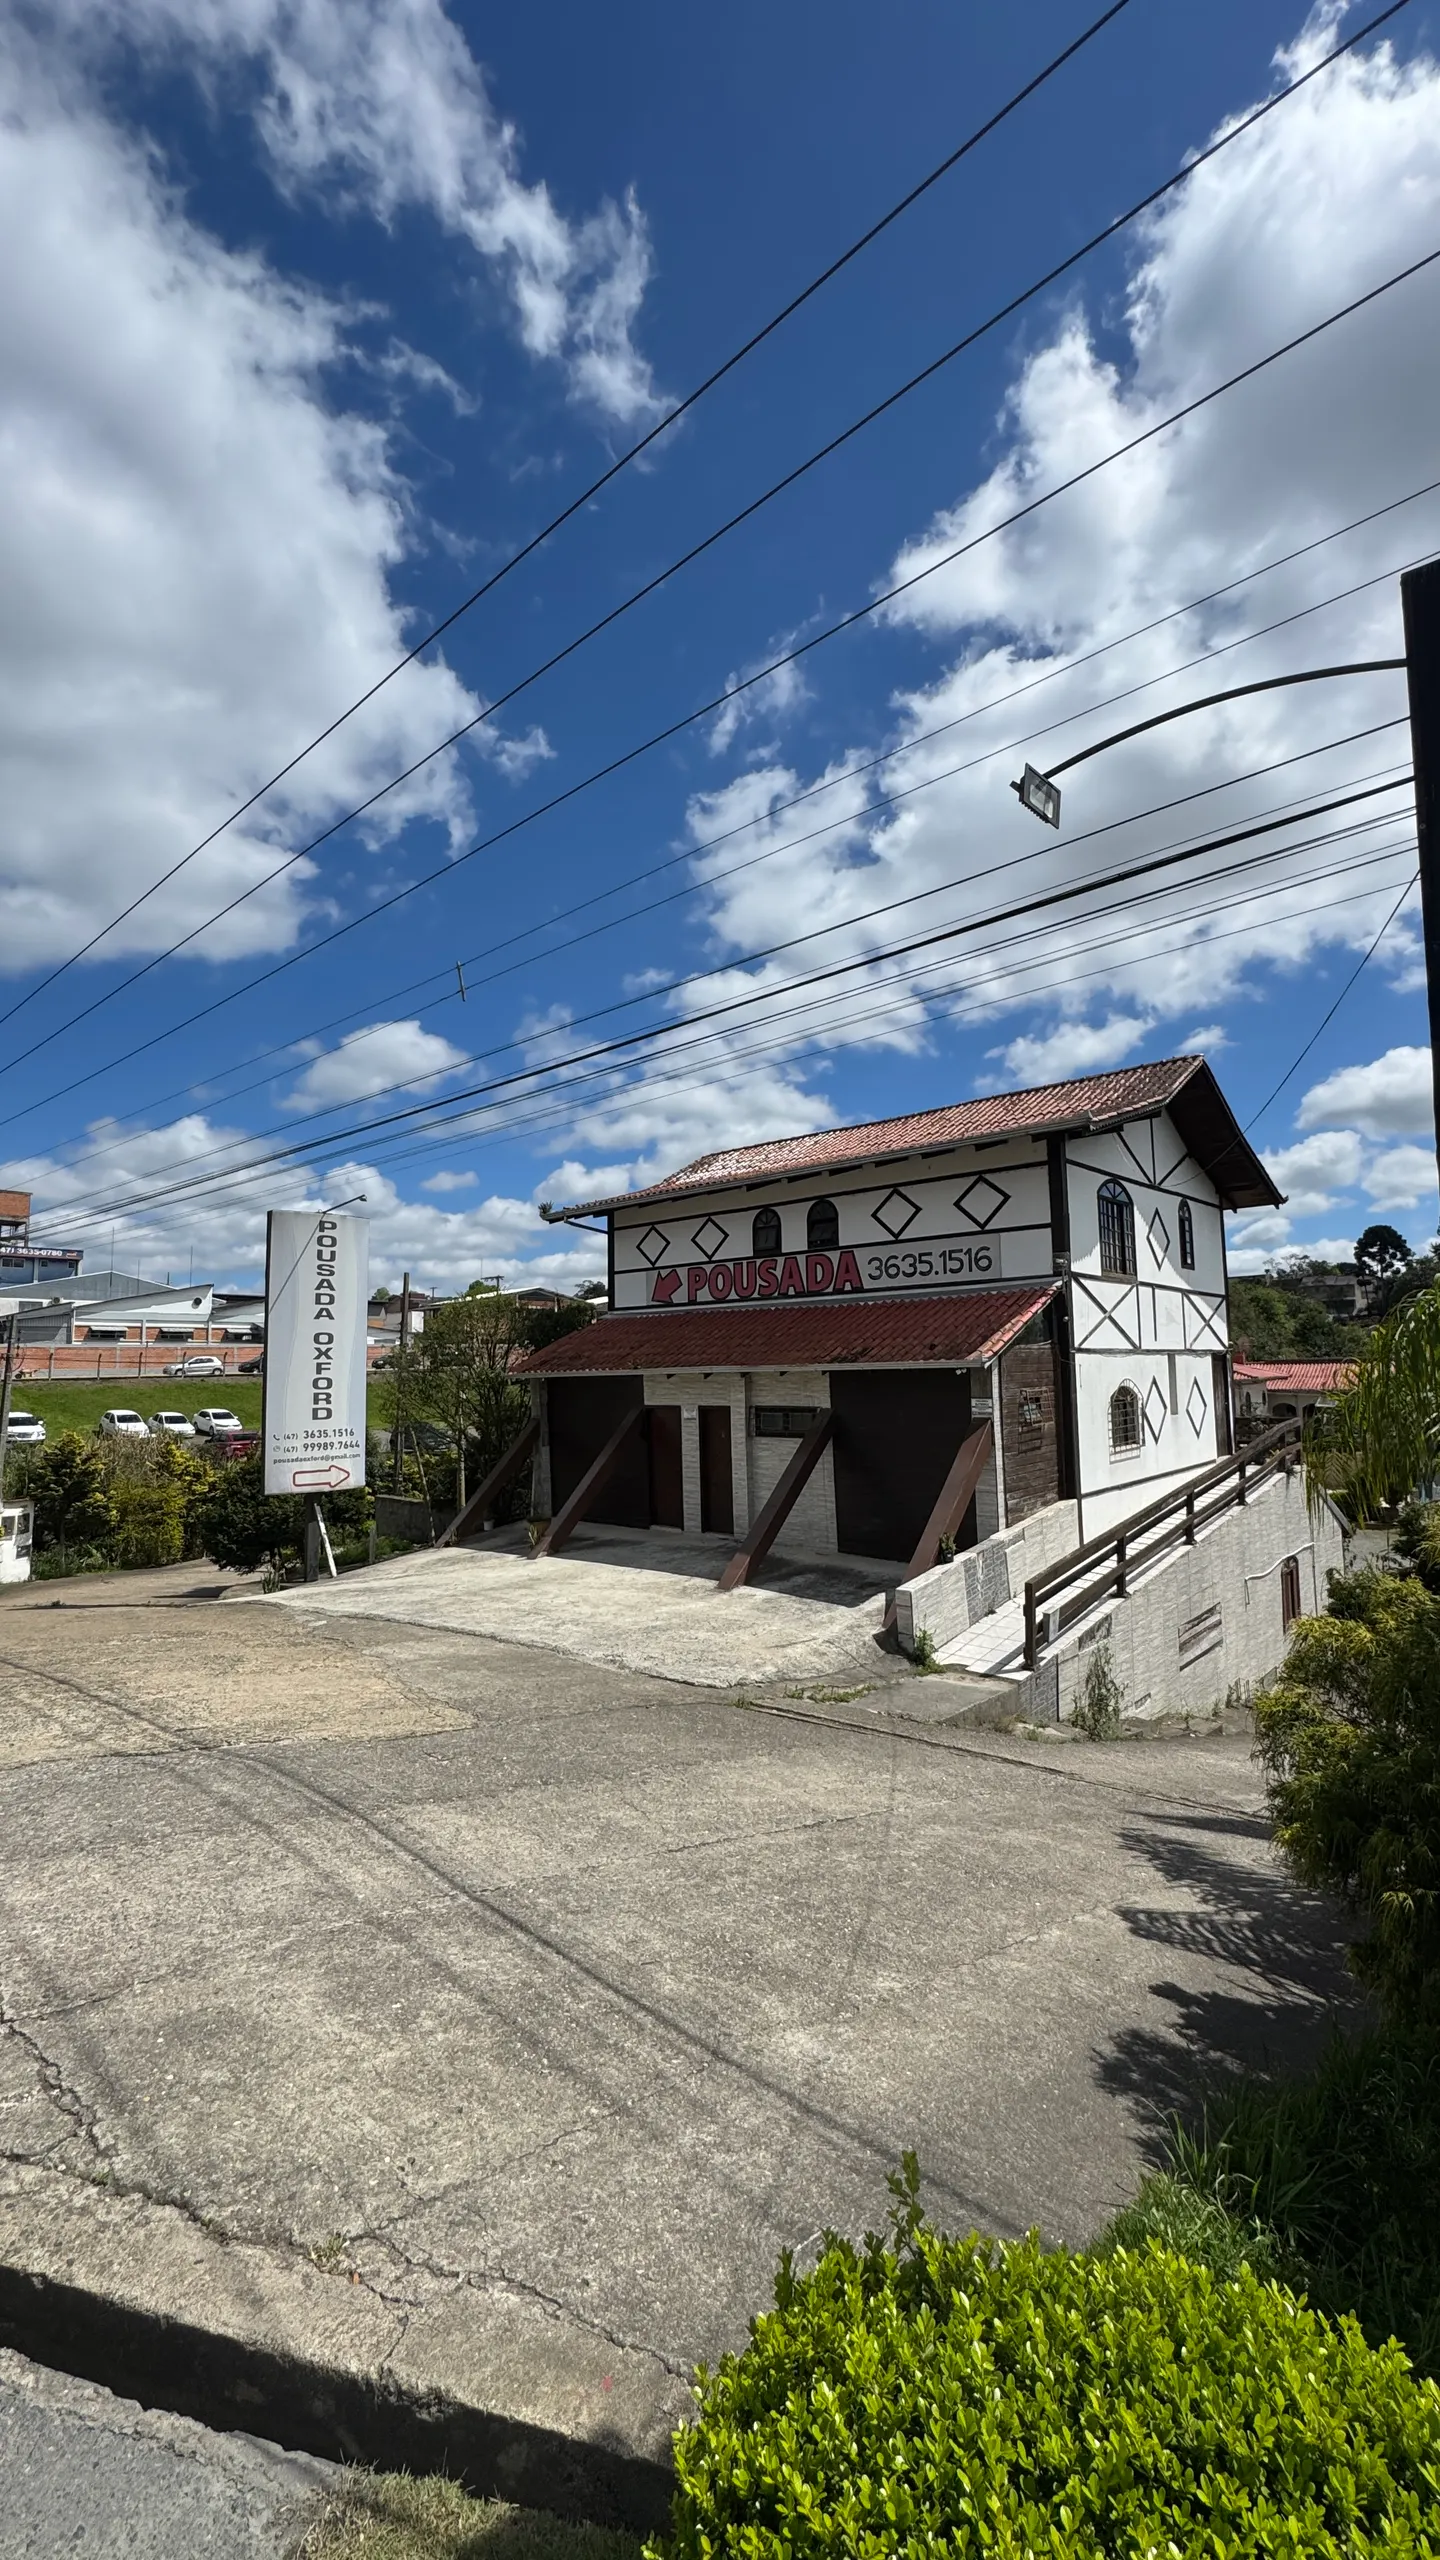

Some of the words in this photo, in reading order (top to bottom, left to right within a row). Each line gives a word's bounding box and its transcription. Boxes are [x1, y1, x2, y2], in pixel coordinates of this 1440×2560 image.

[16, 1247, 63, 1257] 3635-0780
[314, 1220, 338, 1320] POUSADA
[687, 1250, 865, 1302] POUSADA
[867, 1245, 994, 1281] 3635.1516
[312, 1332, 334, 1421] OXFORD
[283, 1433, 298, 1441] (47)
[303, 1427, 355, 1440] 3635.1516
[303, 1440, 360, 1453] 99989.7644
